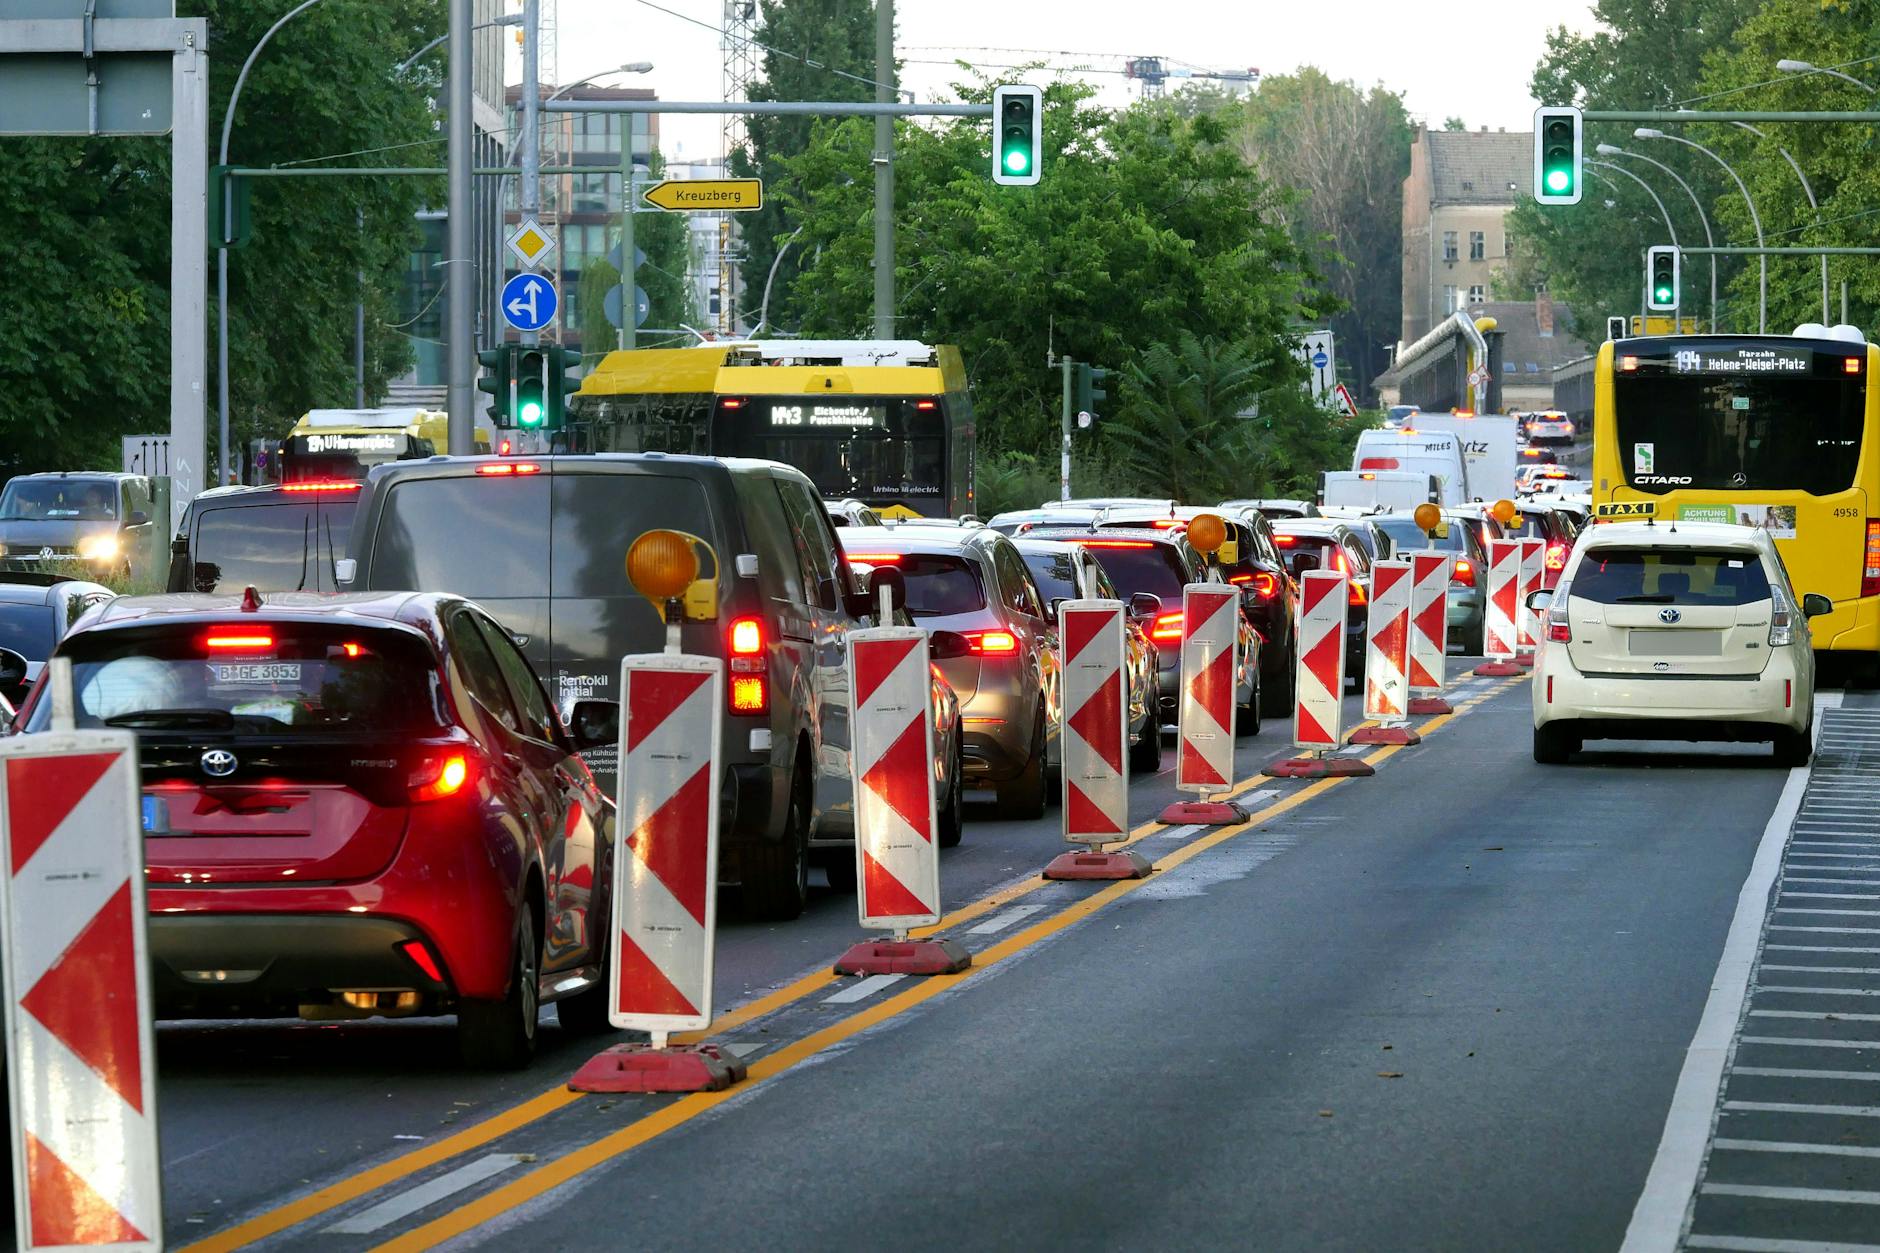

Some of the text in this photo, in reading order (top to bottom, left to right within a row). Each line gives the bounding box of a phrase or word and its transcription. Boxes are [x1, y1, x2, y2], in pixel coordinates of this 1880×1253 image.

[676, 190, 741, 203] Kreuzberg
[1738, 350, 1776, 358] Marzahn
[1674, 350, 1701, 371] 194
[1708, 358, 1806, 371] Helene-Weigel-Platz
[1425, 442, 1451, 452] MILES
[1634, 476, 1692, 485] CITARO
[909, 486, 940, 494] electric
[1604, 503, 1647, 515] TAXI
[1684, 509, 1727, 517] ACHTUNG
[1833, 508, 1858, 518] 4958
[560, 675, 608, 686] Rentokil
[560, 686, 593, 697] Initial
